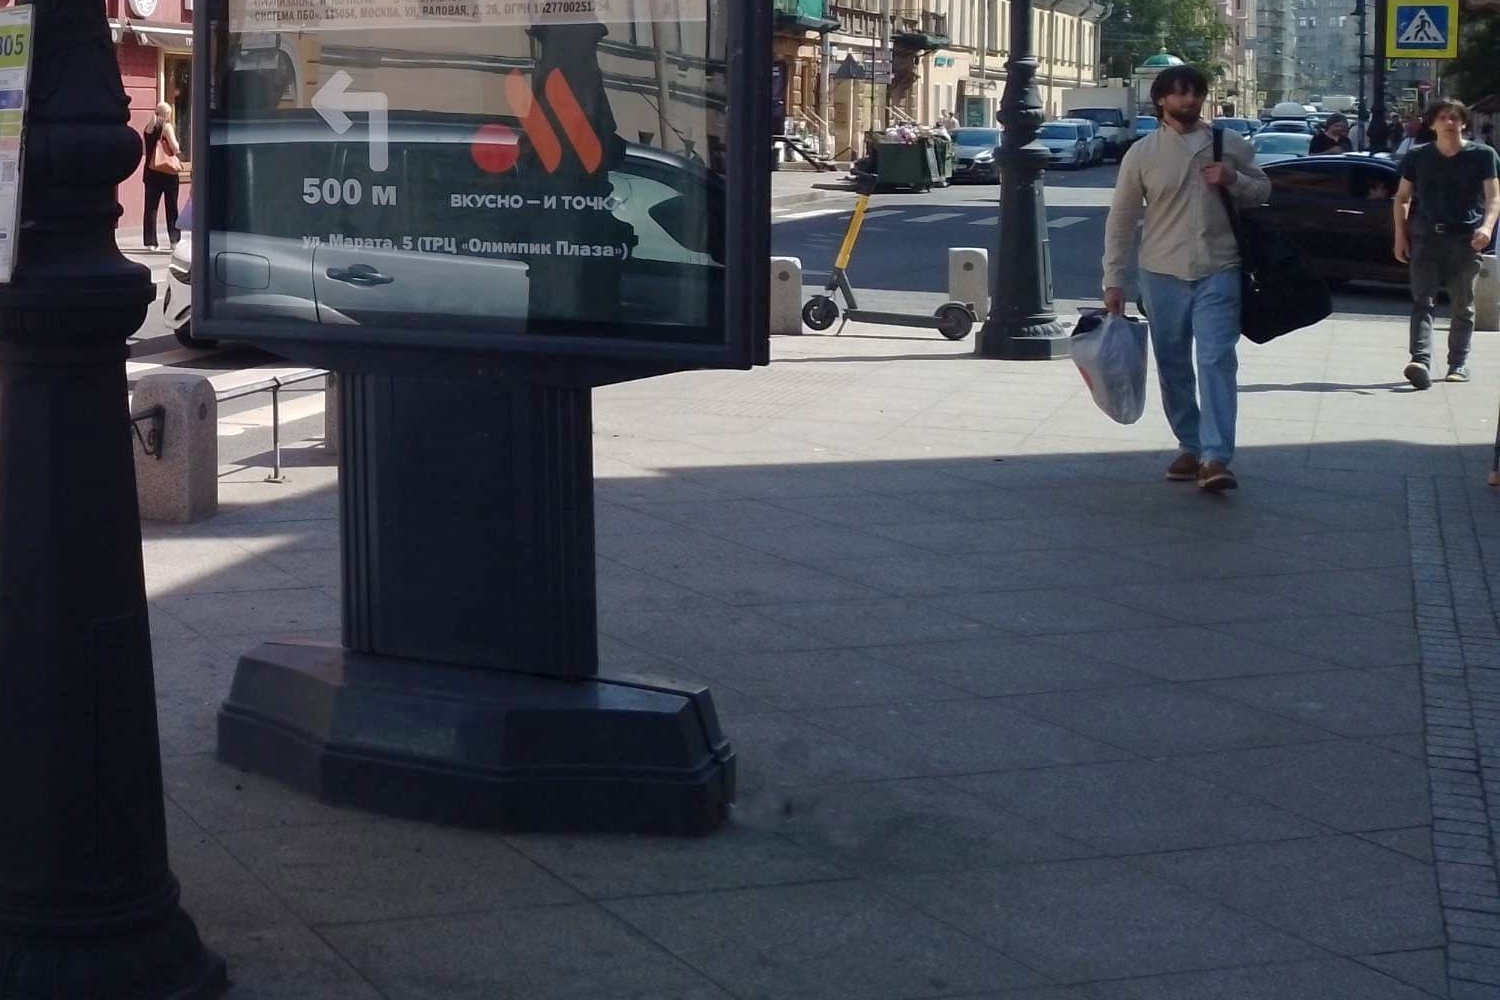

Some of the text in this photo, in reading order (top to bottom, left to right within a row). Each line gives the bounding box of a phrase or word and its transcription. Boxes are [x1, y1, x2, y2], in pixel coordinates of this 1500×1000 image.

[302, 177, 397, 206] 500 м
[451, 193, 523, 209] ВКУСНО
[543, 194, 557, 209] И
[302, 233, 629, 261] ул. Марата, 5 (ТРЦ «Олимпик Плаза»)
